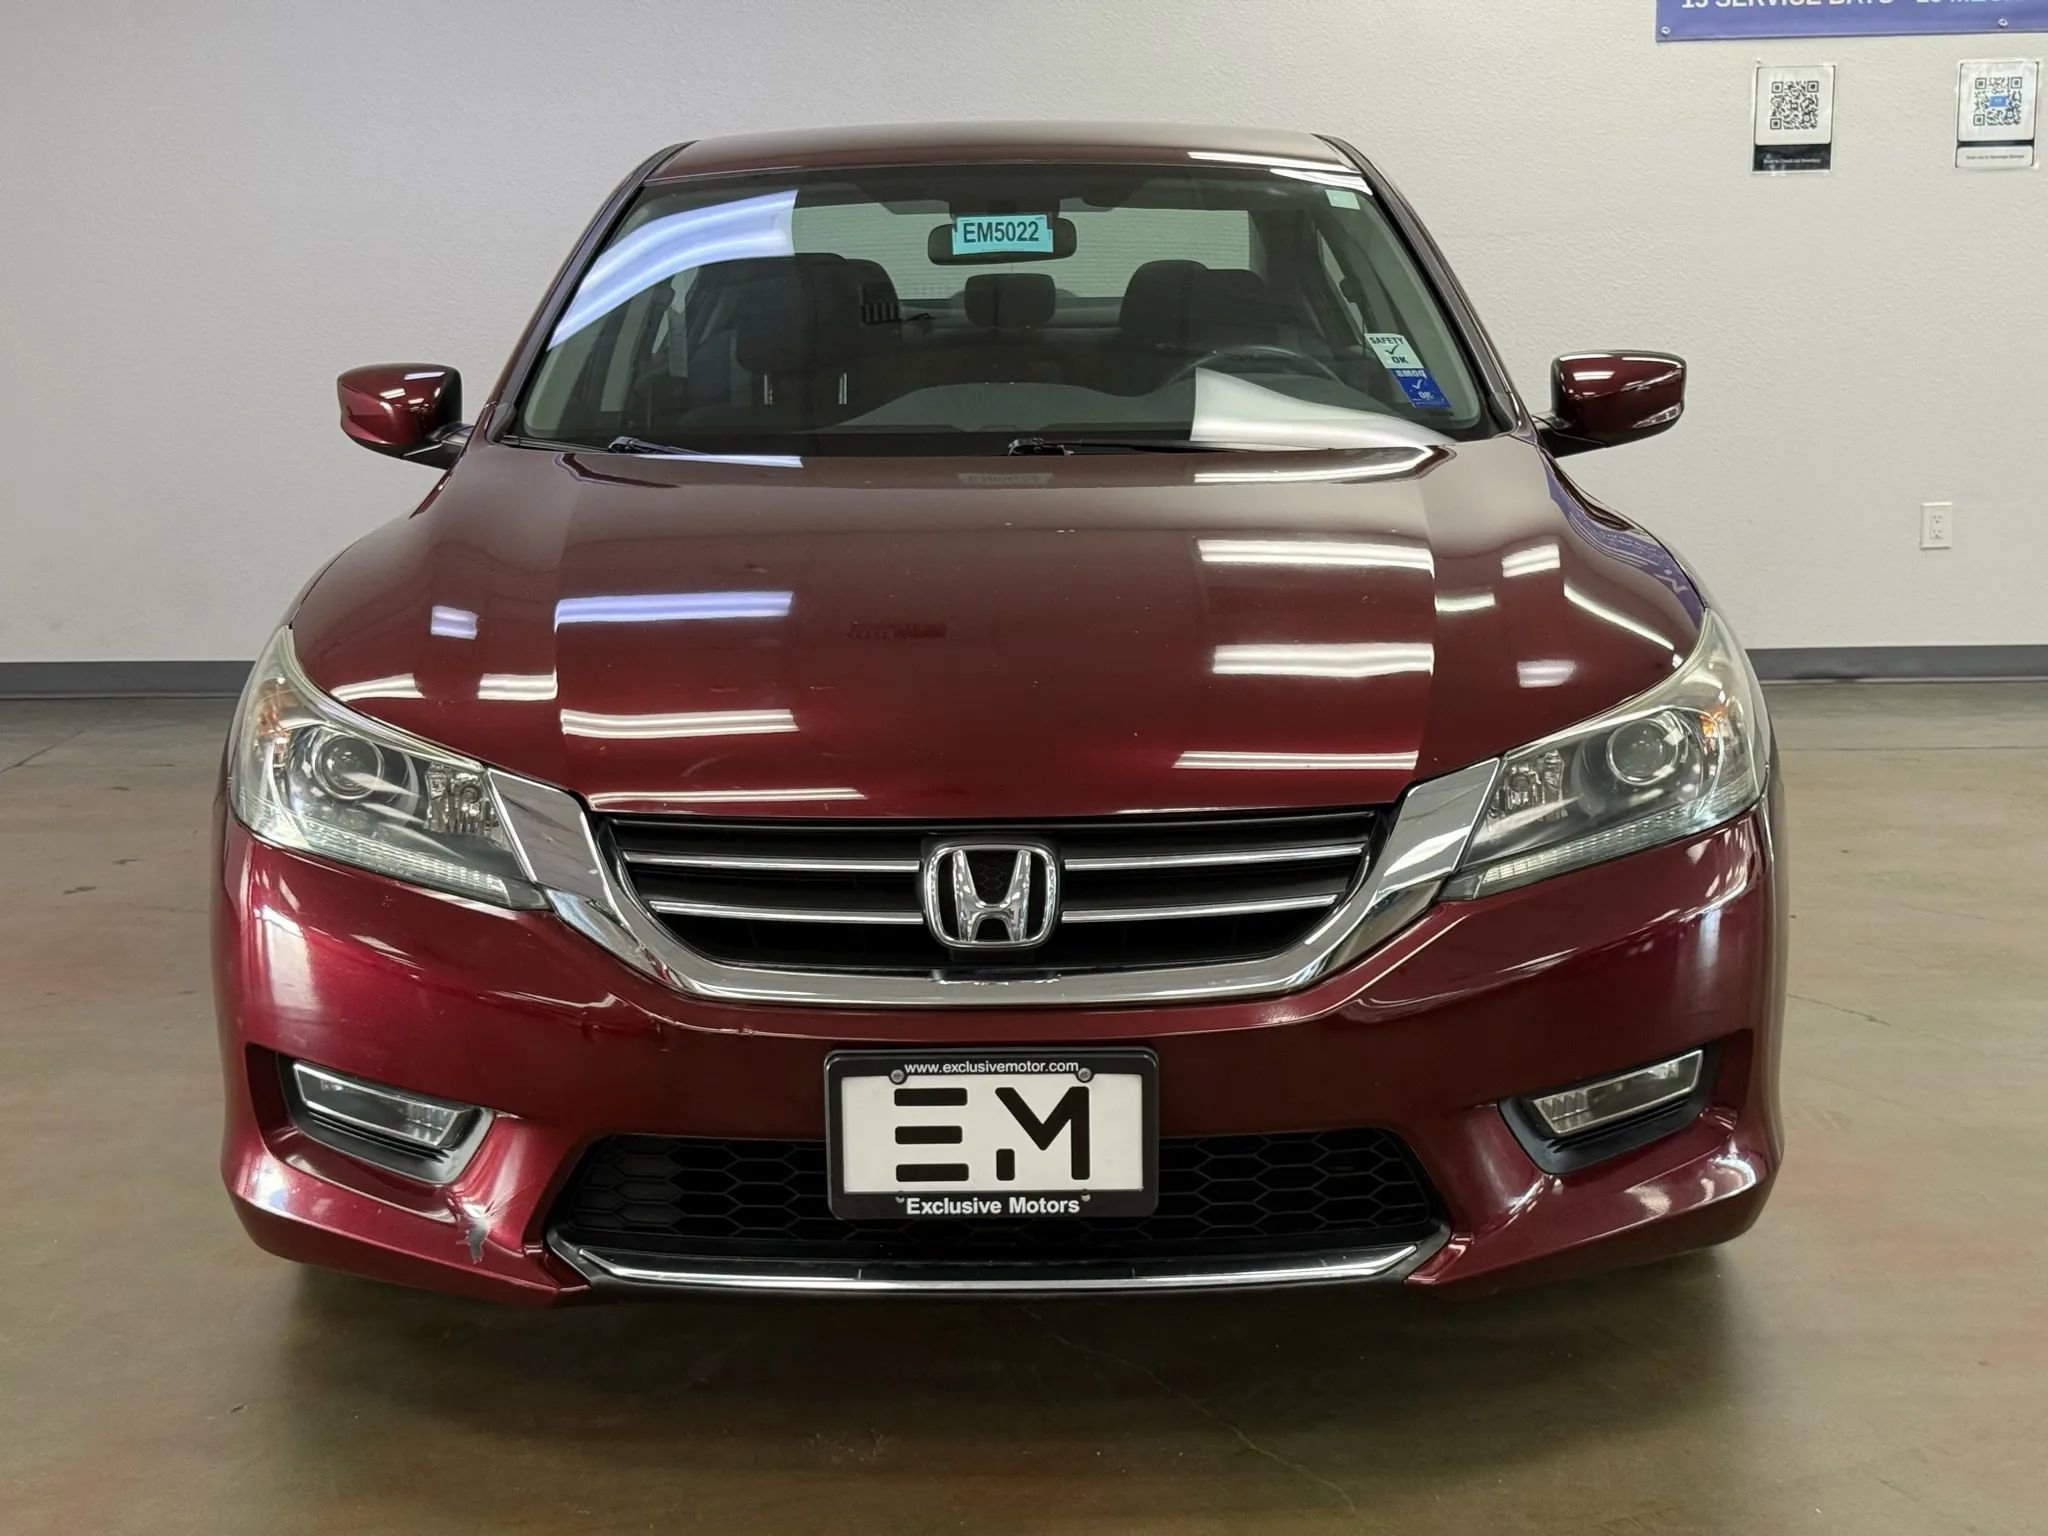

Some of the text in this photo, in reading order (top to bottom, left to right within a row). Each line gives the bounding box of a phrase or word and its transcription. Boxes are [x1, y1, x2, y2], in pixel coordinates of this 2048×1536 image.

[963, 221, 1039, 243] EM5022
[1369, 336, 1404, 345] SAFETY
[1391, 356, 1409, 364] OK
[904, 1060, 1079, 1073] www.exclusivemotor.com
[894, 1085, 1090, 1182] EM
[906, 1197, 1080, 1215] Exclusive Motors
